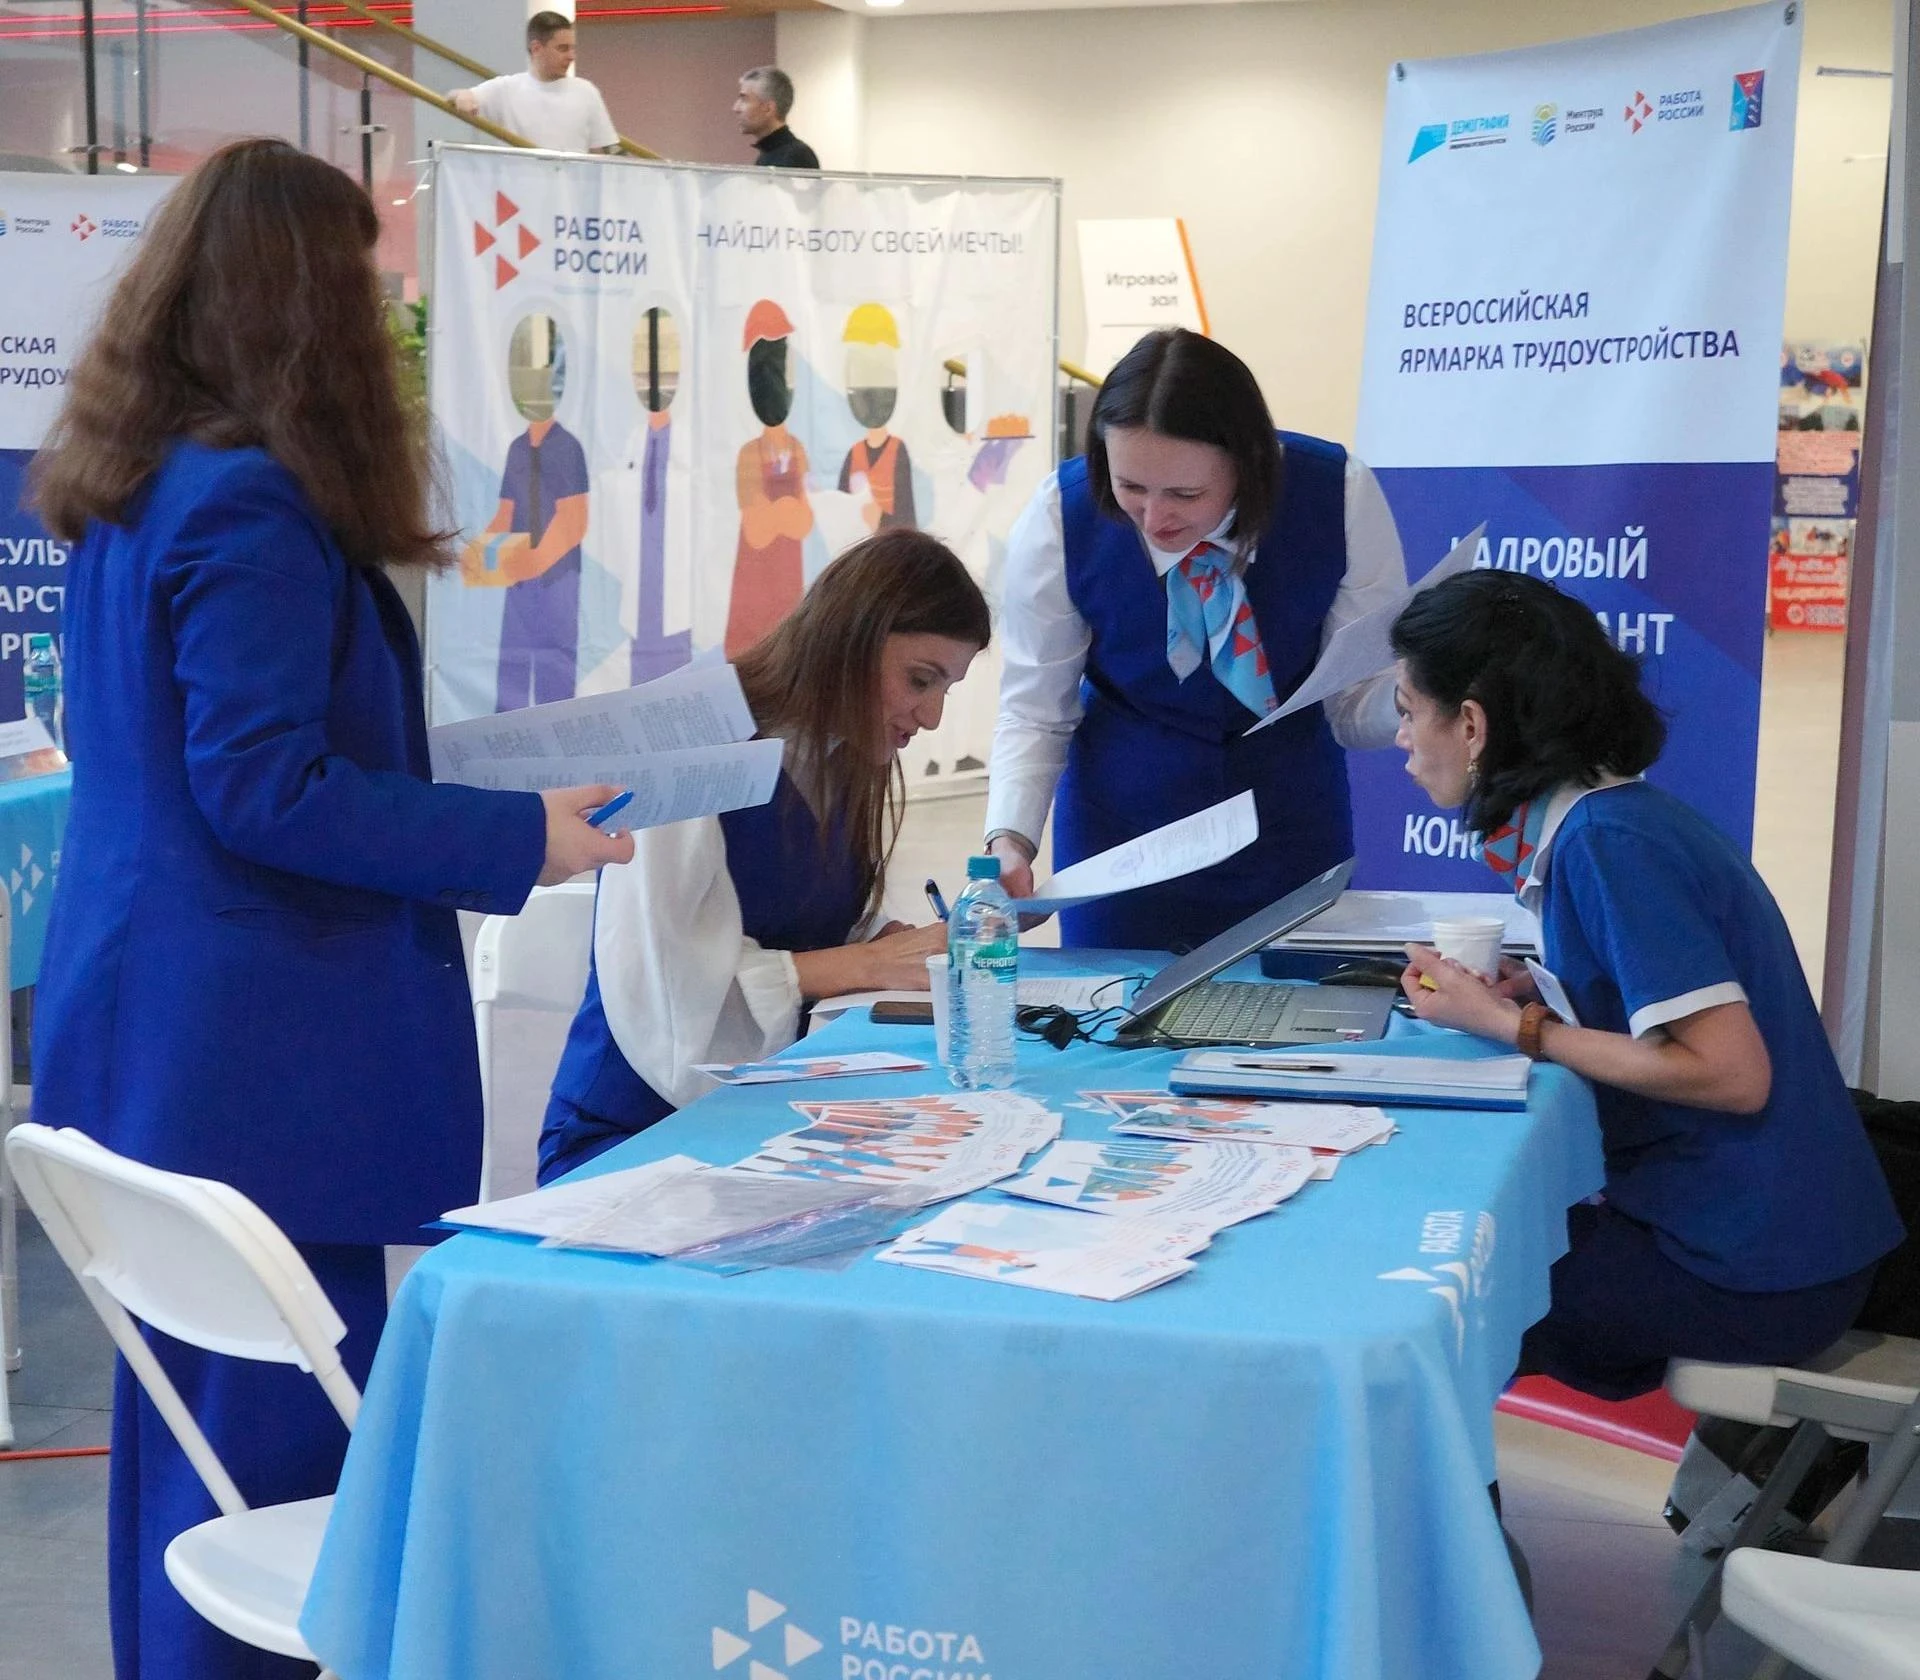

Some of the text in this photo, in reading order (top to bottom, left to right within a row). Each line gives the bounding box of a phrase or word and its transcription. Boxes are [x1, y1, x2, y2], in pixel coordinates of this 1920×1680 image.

[1659, 90, 1703, 106] РАБОТА
[1566, 107, 1604, 120] Минтруд
[1657, 105, 1705, 121] РОССИИ
[1565, 122, 1596, 133] России
[553, 215, 643, 243] РАБОТА
[697, 219, 780, 252] НАЙДИ
[786, 227, 866, 253] РАБОТУ
[871, 227, 945, 253] СВОЕЙ
[553, 248, 648, 275] РОССИИ
[1106, 271, 1178, 288] Игровой
[1403, 290, 1590, 328] ВСЕРОССИЙСКАЯ
[1399, 325, 1740, 373] ЯРМАРКА ТРУДОУСТРОЙСТВА
[840, 1615, 985, 1664] РАБОТА
